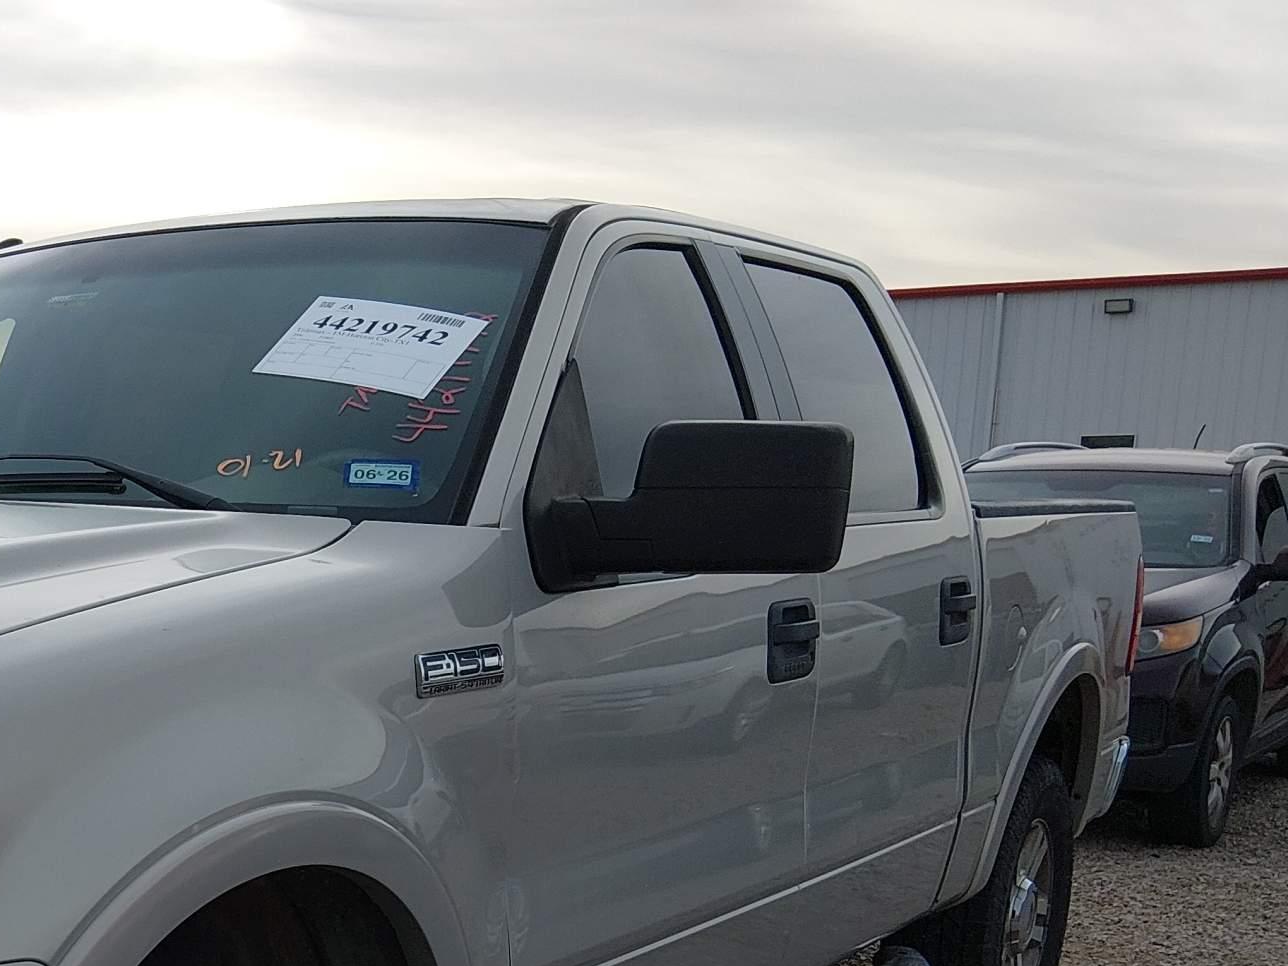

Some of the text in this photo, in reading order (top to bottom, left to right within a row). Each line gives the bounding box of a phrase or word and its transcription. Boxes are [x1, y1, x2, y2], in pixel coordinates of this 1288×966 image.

[312, 315, 449, 346] 44219742
[354, 469, 409, 481] 06 26
